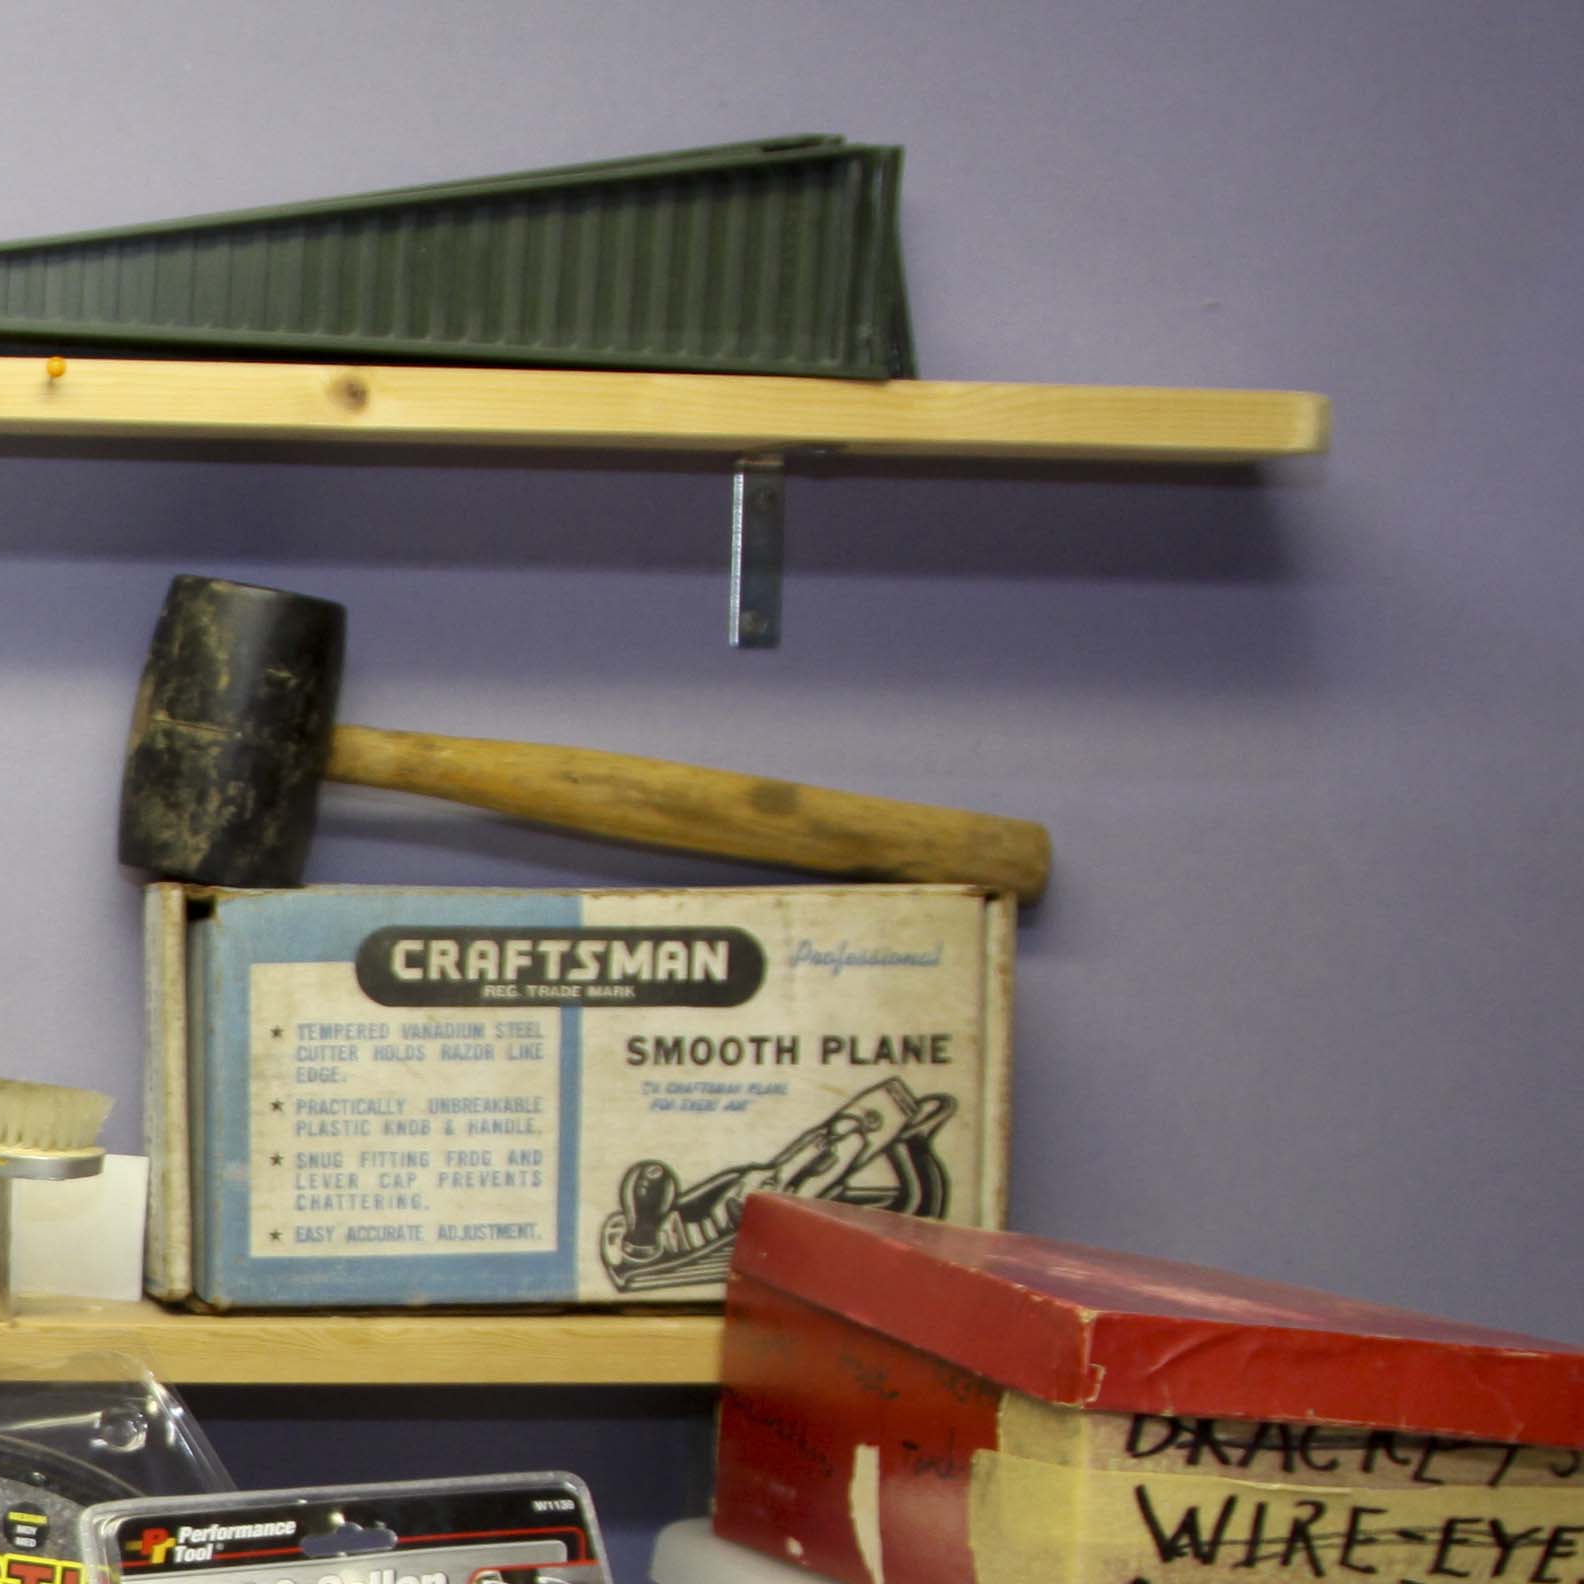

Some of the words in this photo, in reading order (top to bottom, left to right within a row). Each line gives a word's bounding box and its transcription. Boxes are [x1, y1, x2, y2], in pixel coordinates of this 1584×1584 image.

[390, 938, 730, 982] CRAFTSMAN
[790, 940, 945, 975] Professional
[527, 984, 582, 998] TRADE
[587, 985, 636, 998] MARK
[296, 1023, 390, 1040] TEMPERED
[400, 1023, 485, 1039] VANADIUM
[494, 1022, 544, 1038] STEEL
[295, 1045, 359, 1062] CUTTER
[373, 1045, 426, 1061] HOLDS
[440, 1045, 495, 1061] RAZOR
[506, 1044, 544, 1060] LIKE
[625, 1035, 800, 1066] SMOOTH
[821, 1033, 953, 1065] PLANE
[295, 1067, 347, 1084] EDGE.
[295, 1099, 406, 1116] PRACTICALLY
[428, 1098, 542, 1114] UNBREAKABLE
[295, 1120, 371, 1137] PLASTIC
[383, 1119, 431, 1137] KNOB
[467, 1119, 542, 1136] HANDLE.
[177, 1518, 297, 1544] Performance
[173, 1543, 215, 1564] Tool
